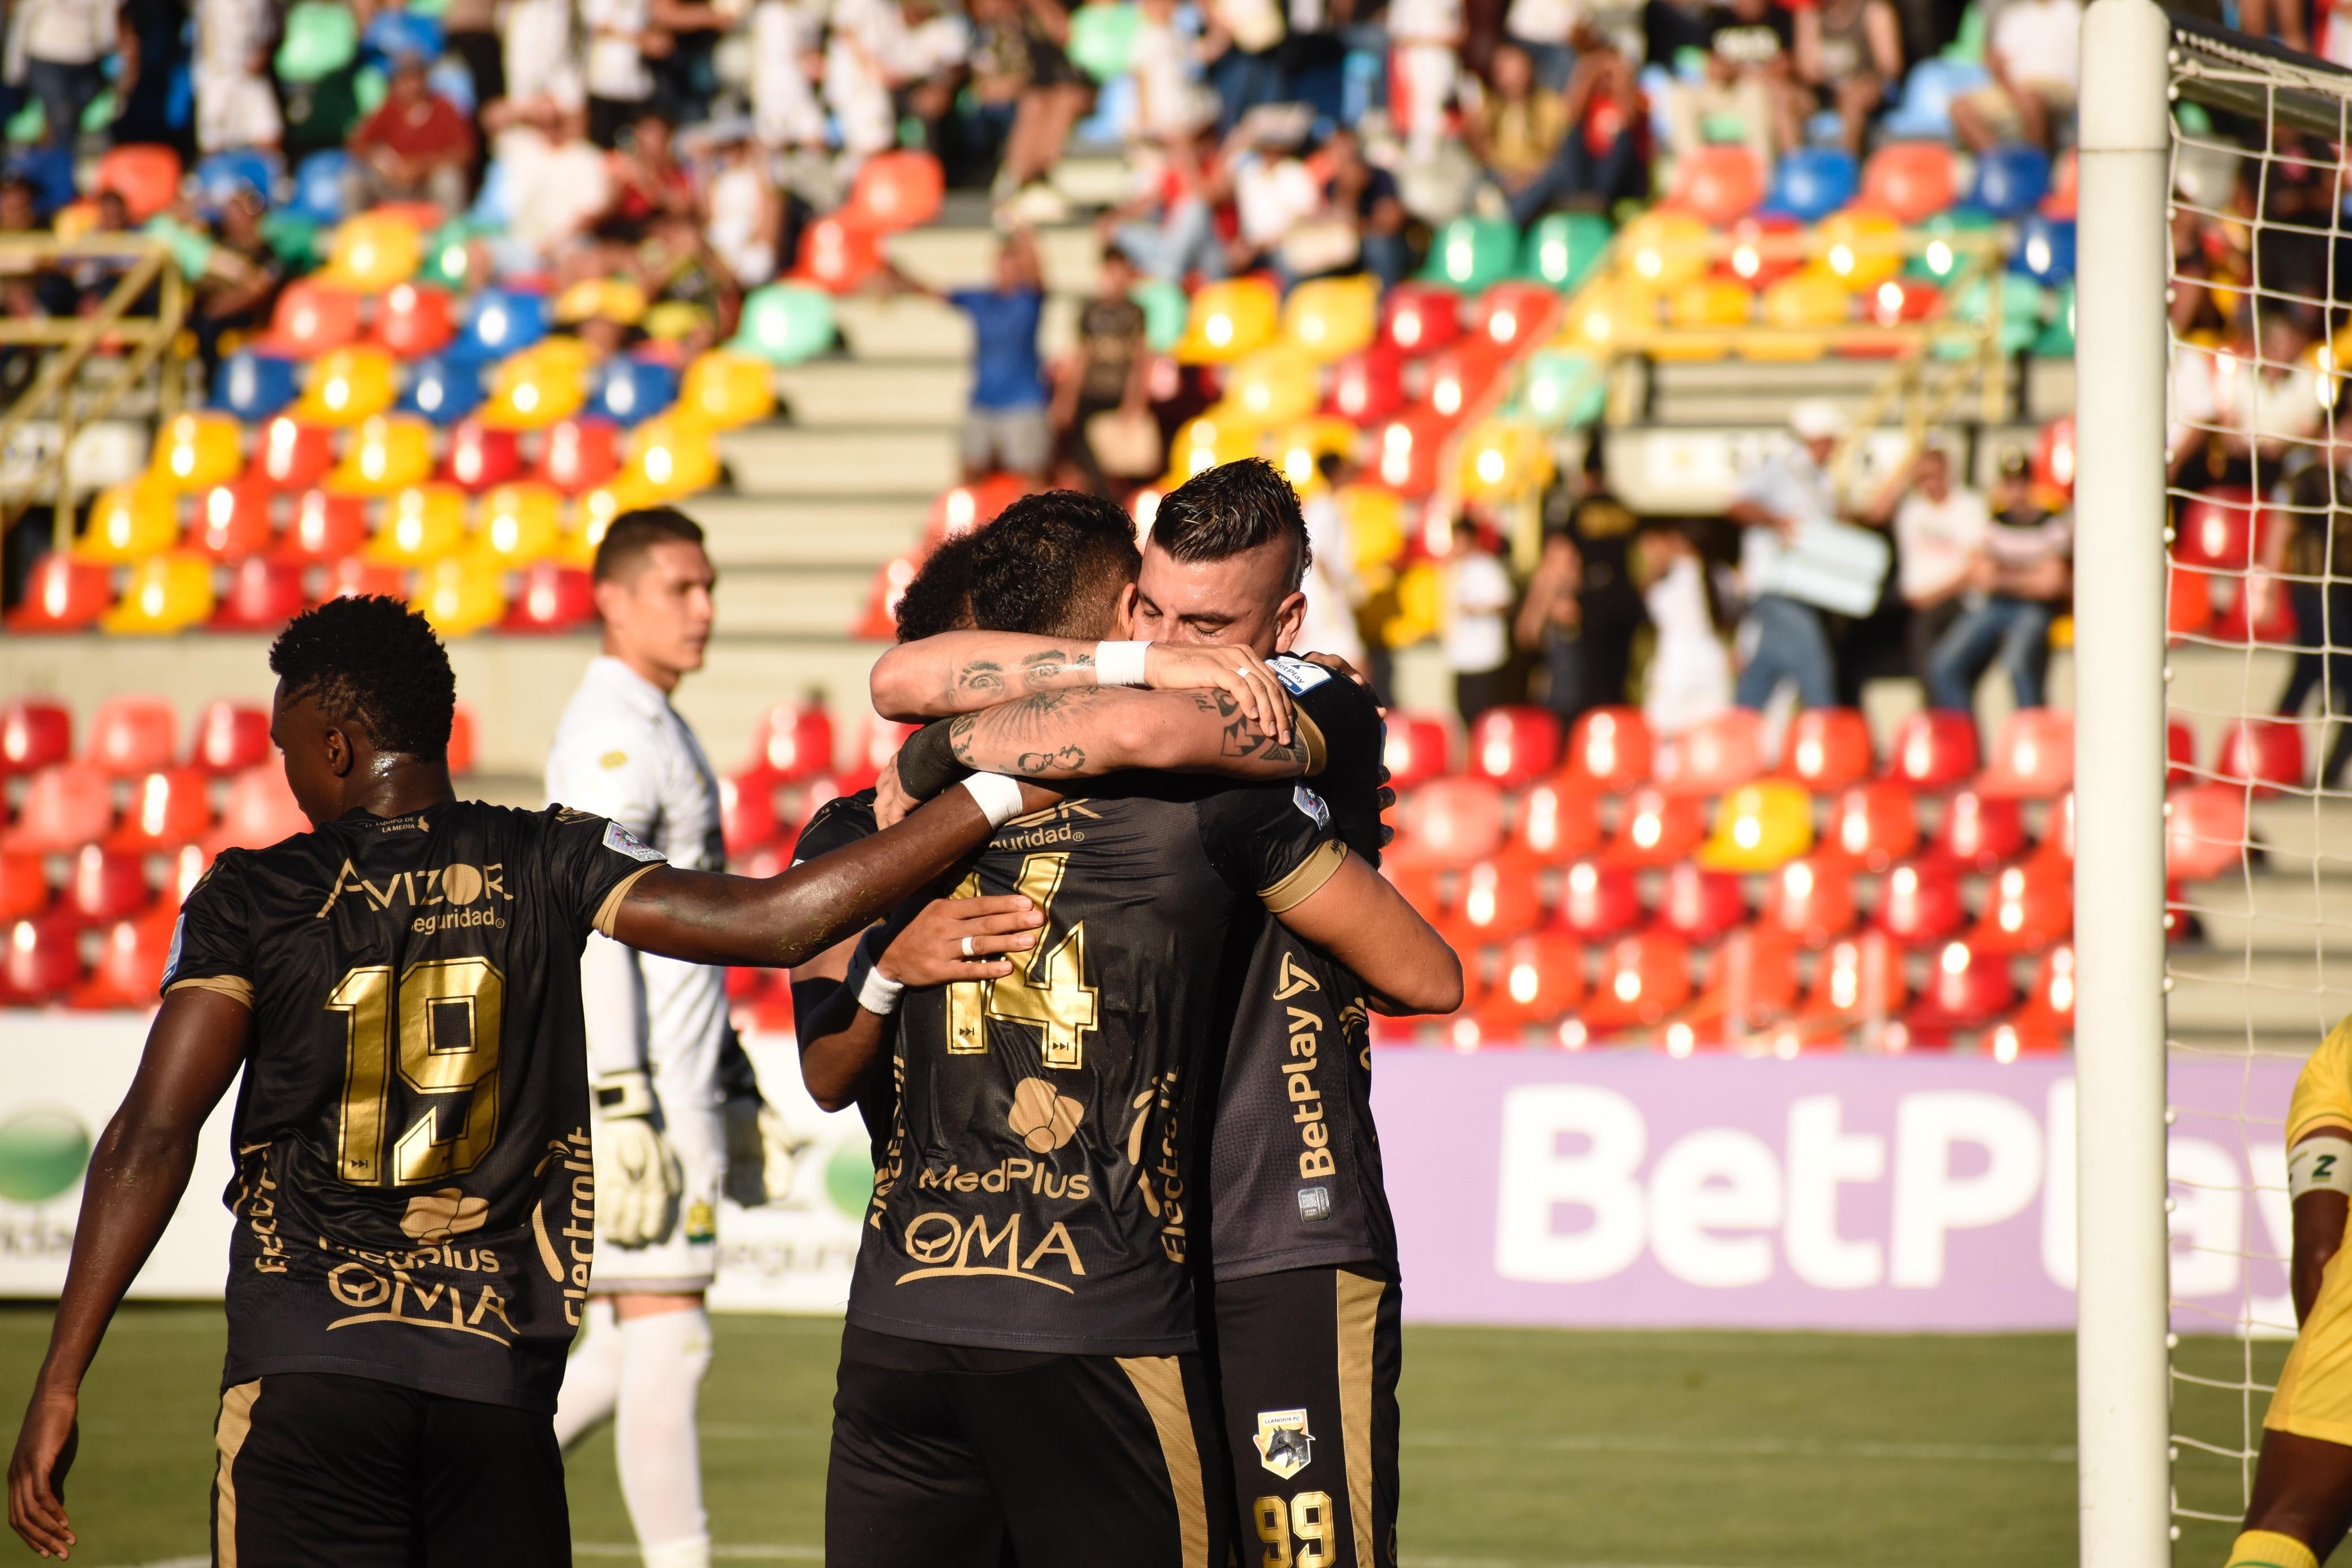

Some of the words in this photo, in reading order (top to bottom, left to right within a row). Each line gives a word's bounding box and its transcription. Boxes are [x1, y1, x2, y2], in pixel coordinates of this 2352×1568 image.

[1273, 661, 1305, 683] BetPlay
[1278, 675, 1292, 687] AYOR
[317, 858, 513, 918] AVIZOR
[946, 852, 1099, 1070] 14
[324, 956, 506, 1186] 19
[1281, 1006, 1335, 1179] BetPlay
[919, 1158, 1090, 1200] MedPlus
[905, 1212, 1086, 1275] OMA
[328, 1262, 520, 1335] OMA
[1253, 1491, 1336, 1568] 99
